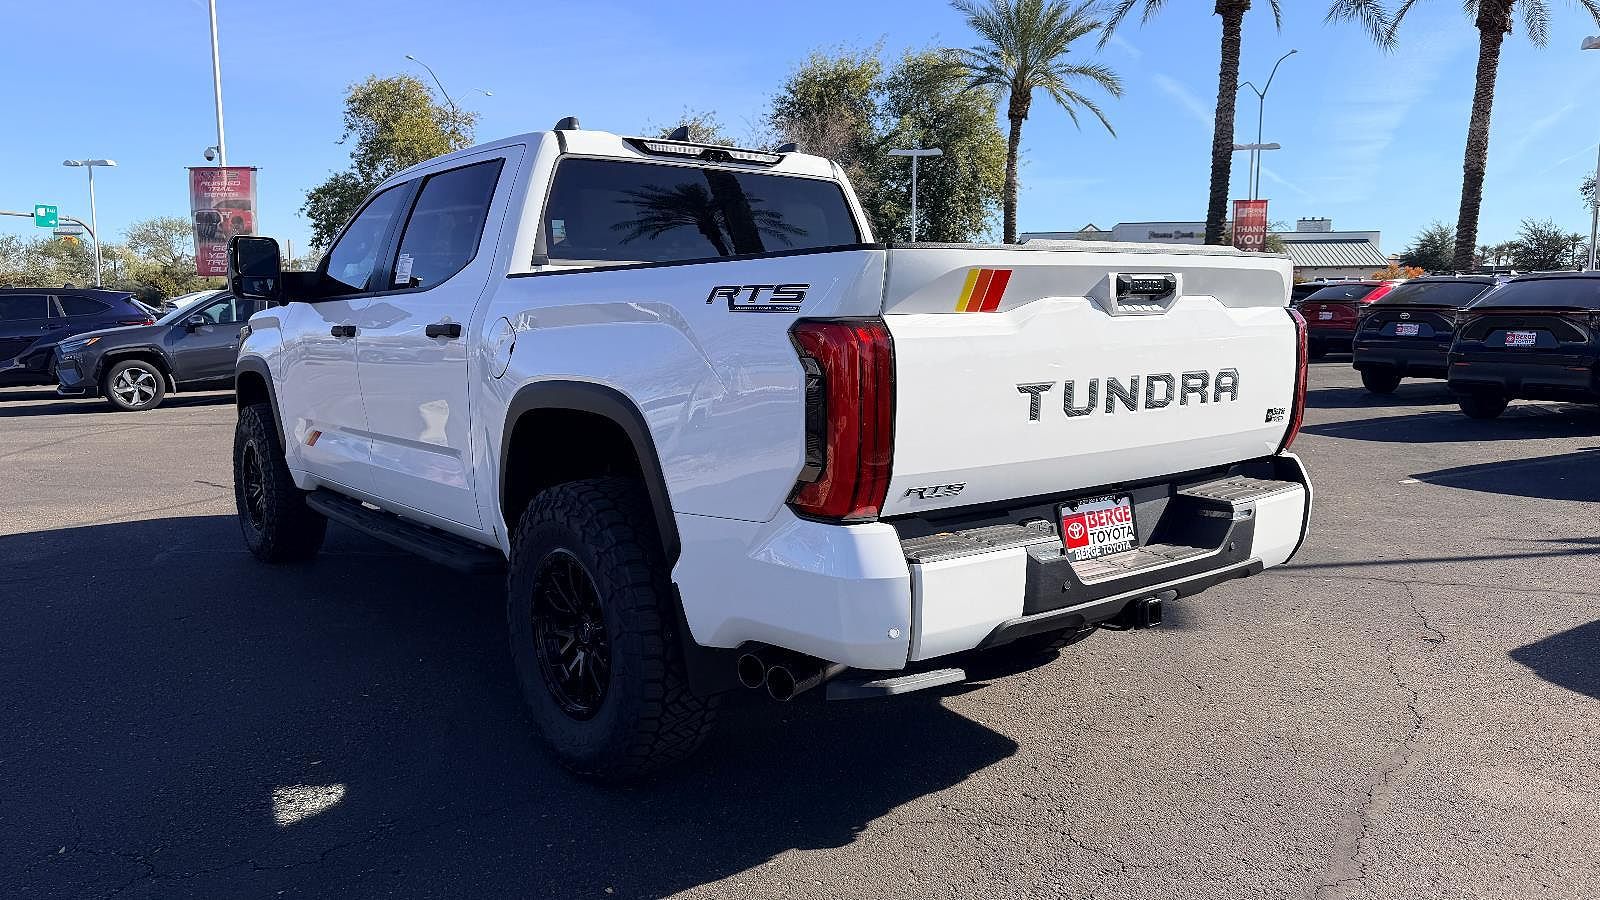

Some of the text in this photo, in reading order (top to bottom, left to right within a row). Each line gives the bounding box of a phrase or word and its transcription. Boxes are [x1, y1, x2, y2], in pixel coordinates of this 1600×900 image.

[1236, 225, 1266, 233] THANK
[1237, 235, 1264, 245] YOU
[706, 284, 811, 306] RTS
[1015, 367, 1240, 422] TUNDRA
[904, 481, 967, 499] RTS
[1086, 505, 1131, 528] BERGE
[1089, 525, 1135, 544] TOYOTA
[1074, 541, 1132, 560] BERGE TOYOTA
